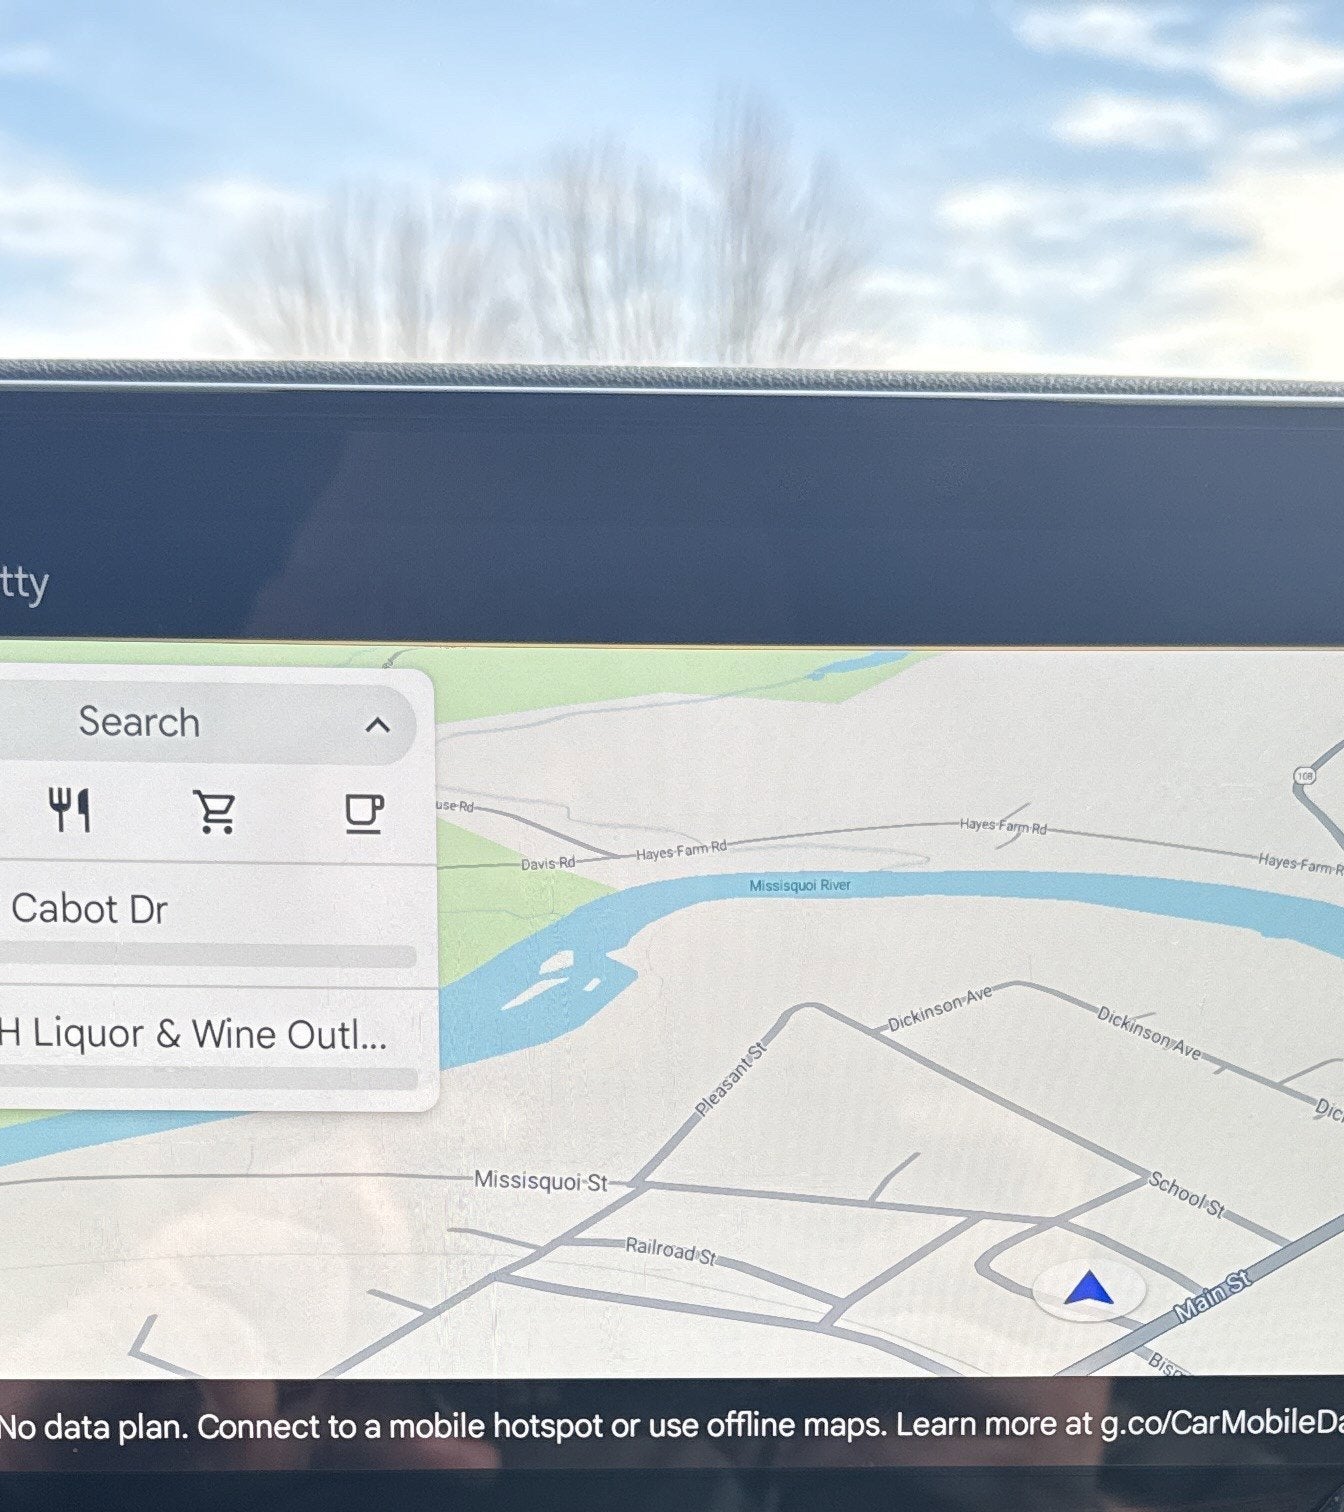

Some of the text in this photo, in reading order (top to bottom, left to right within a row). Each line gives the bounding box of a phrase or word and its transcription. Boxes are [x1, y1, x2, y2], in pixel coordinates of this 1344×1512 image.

[78, 704, 201, 740] Search
[1297, 771, 1314, 782] 108
[459, 800, 475, 813] Rd
[960, 818, 1047, 836] Hayes Farm Rd
[521, 854, 576, 871] Davis Rd
[637, 839, 728, 863] Hayes Farm Rd
[1258, 852, 1297, 870] Hayes
[1300, 858, 1332, 875] Farm
[750, 878, 852, 894] Missisquoi River
[12, 890, 119, 924] Cabot
[130, 894, 169, 924] Dr
[888, 985, 993, 1033] Dickinson Ave
[34, 1014, 145, 1056] Liquor
[157, 1018, 181, 1048] &
[192, 1017, 276, 1049] Wine
[288, 1018, 387, 1050] Outl...
[1097, 1005, 1202, 1061] Dickinson Ave
[695, 1041, 768, 1118] Pleasant St
[474, 1169, 608, 1194] Missisquoi St
[1148, 1170, 1226, 1220] School St
[625, 1236, 717, 1267] Railroad St
[1173, 1269, 1253, 1324] Main St
[44, 1412, 110, 1439] data
[118, 1412, 188, 1446] plan.
[197, 1413, 320, 1439] Connect
[328, 1414, 357, 1439] to
[364, 1418, 381, 1439] a
[389, 1411, 485, 1439] mobile
[494, 1411, 603, 1445] hotspot
[611, 1417, 641, 1438] or
[649, 1418, 699, 1438] use
[707, 1409, 795, 1437] offline
[804, 1416, 887, 1443] maps.
[897, 1411, 975, 1437] Learn
[984, 1413, 1057, 1436] more
[1065, 1411, 1092, 1436] at
